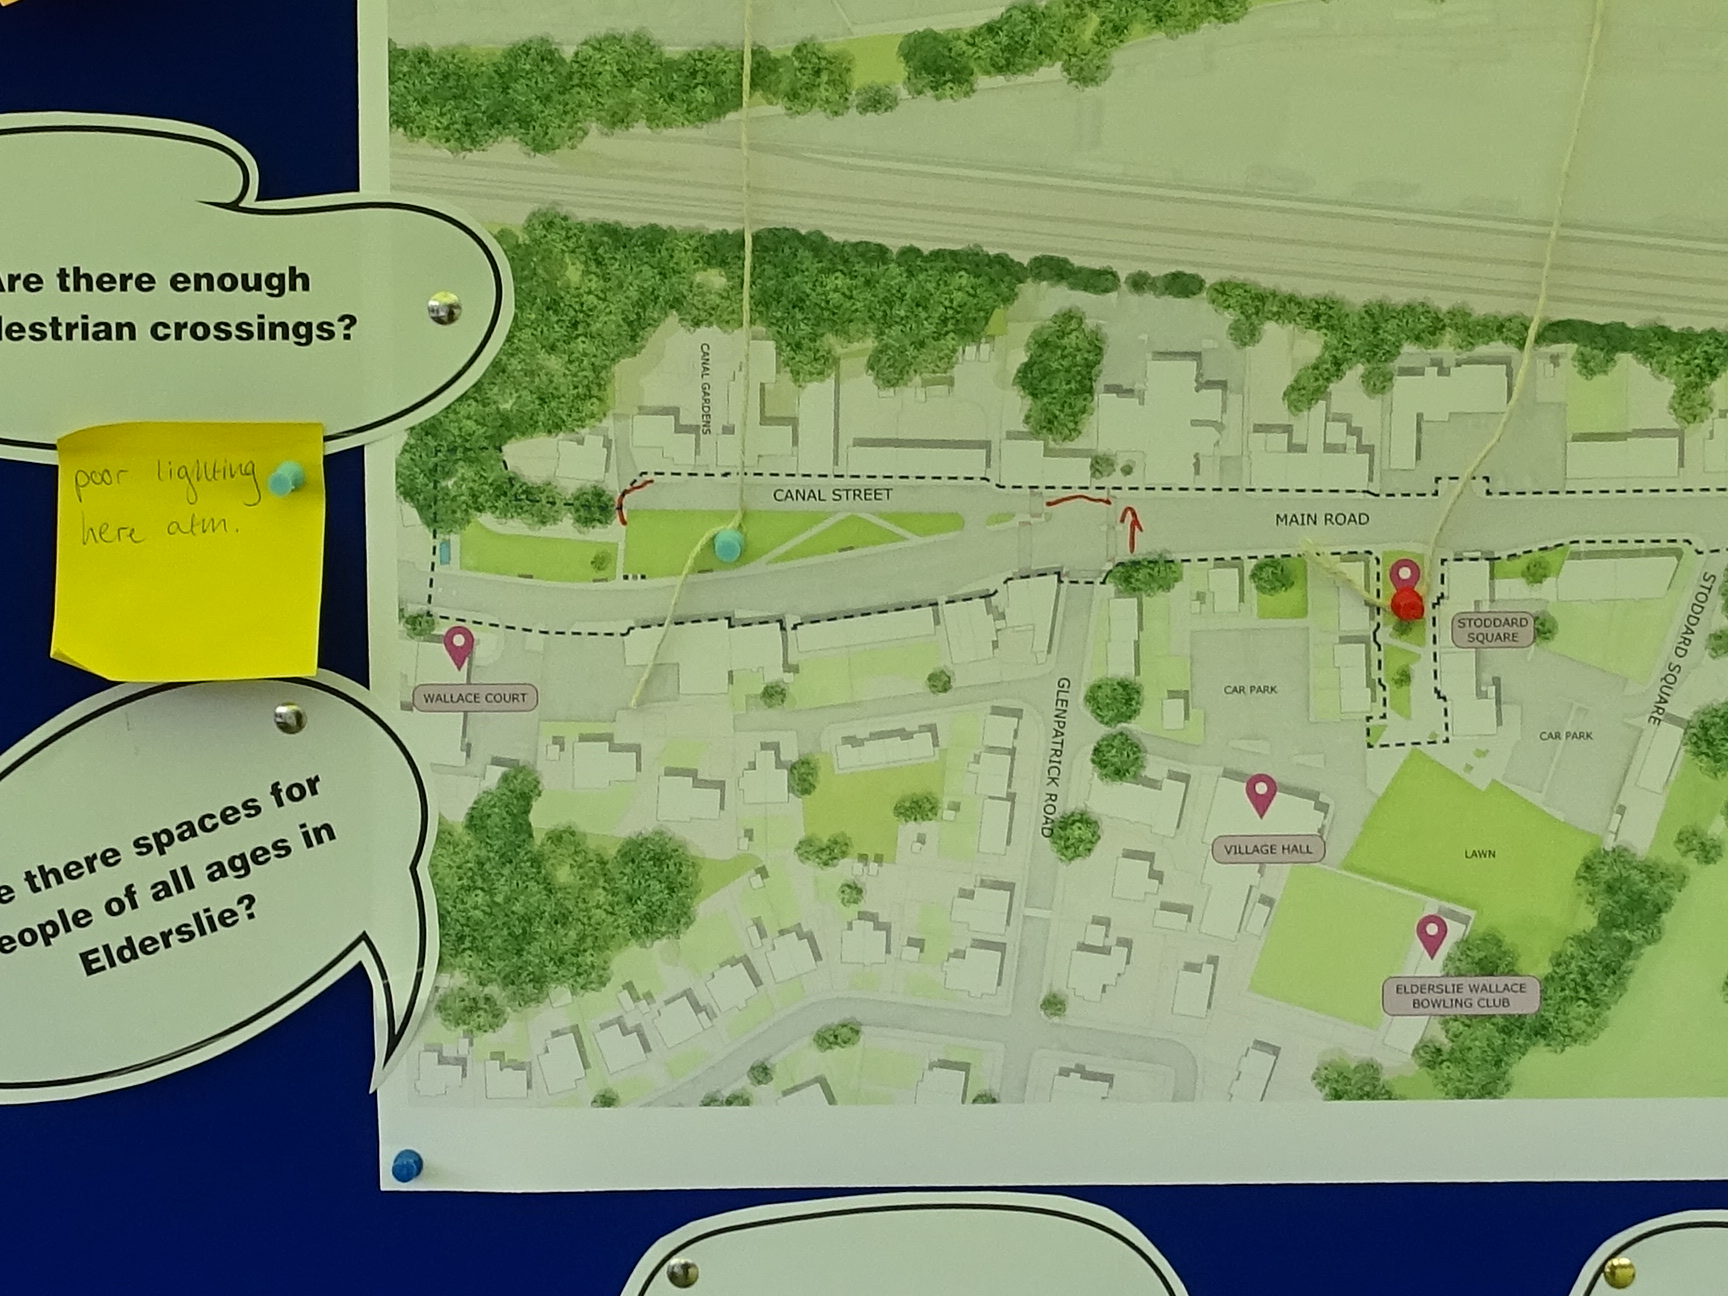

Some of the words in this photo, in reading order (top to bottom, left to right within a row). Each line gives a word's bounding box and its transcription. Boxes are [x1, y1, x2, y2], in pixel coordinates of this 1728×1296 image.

[55, 265, 156, 293] there
[169, 265, 310, 298] enough
[149, 313, 357, 347] crossings?
[700, 342, 711, 380] CANAL
[701, 382, 712, 435] GARDENS
[75, 468, 129, 503] poor
[157, 459, 262, 507] lighting
[773, 488, 827, 503] CANAL
[832, 487, 894, 502] STREET
[81, 510, 146, 545] here
[167, 513, 239, 536] atm.
[1275, 513, 1317, 527] MAIN
[1324, 512, 1370, 526] ROAD
[1457, 616, 1529, 629] STODDARD
[1674, 571, 1717, 659] STODDARD
[1466, 631, 1519, 645] SQUARE
[422, 692, 481, 704] WALLACE
[484, 692, 528, 704] COURT
[1223, 685, 1246, 695] CAR
[1249, 685, 1278, 695] PARK
[1647, 661, 1682, 727] SQUARE
[1046, 677, 1071, 788] GLENPATRICK
[1539, 730, 1562, 741] CAR
[1565, 730, 1594, 741] PARK
[1040, 792, 1058, 840] ROAD
[1223, 843, 1277, 856] VILLAGE
[1281, 843, 1314, 855] HALL
[1464, 849, 1496, 860] LAWN
[1395, 982, 1464, 995] ELDERSLIE
[1468, 983, 1527, 994] WALLACE
[1412, 998, 1473, 1010] BOWLING
[1477, 997, 1511, 1009] CLUB
